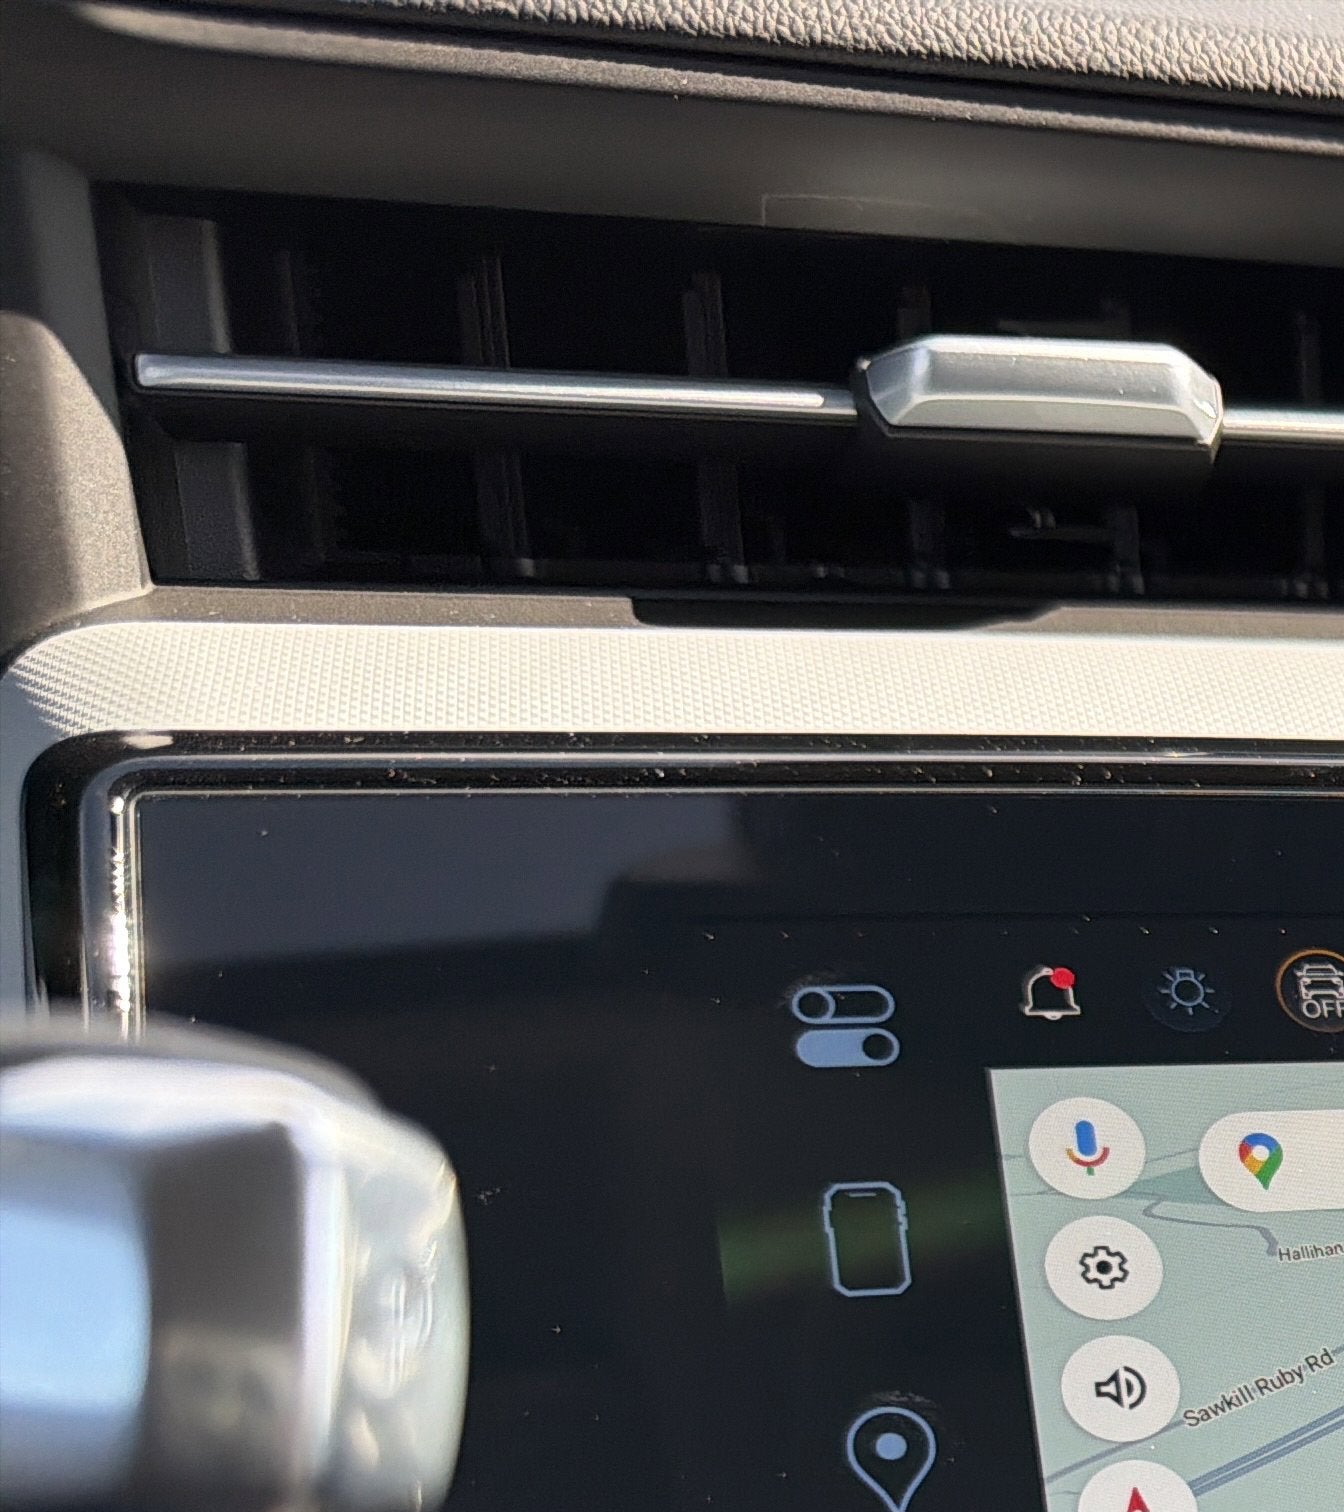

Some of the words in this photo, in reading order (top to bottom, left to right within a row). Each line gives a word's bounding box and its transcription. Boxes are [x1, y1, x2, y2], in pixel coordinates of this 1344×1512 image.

[1183, 1385, 1252, 1428] Sawkill
[1254, 1361, 1305, 1396] Ruby
[1307, 1348, 1335, 1373] Rd
